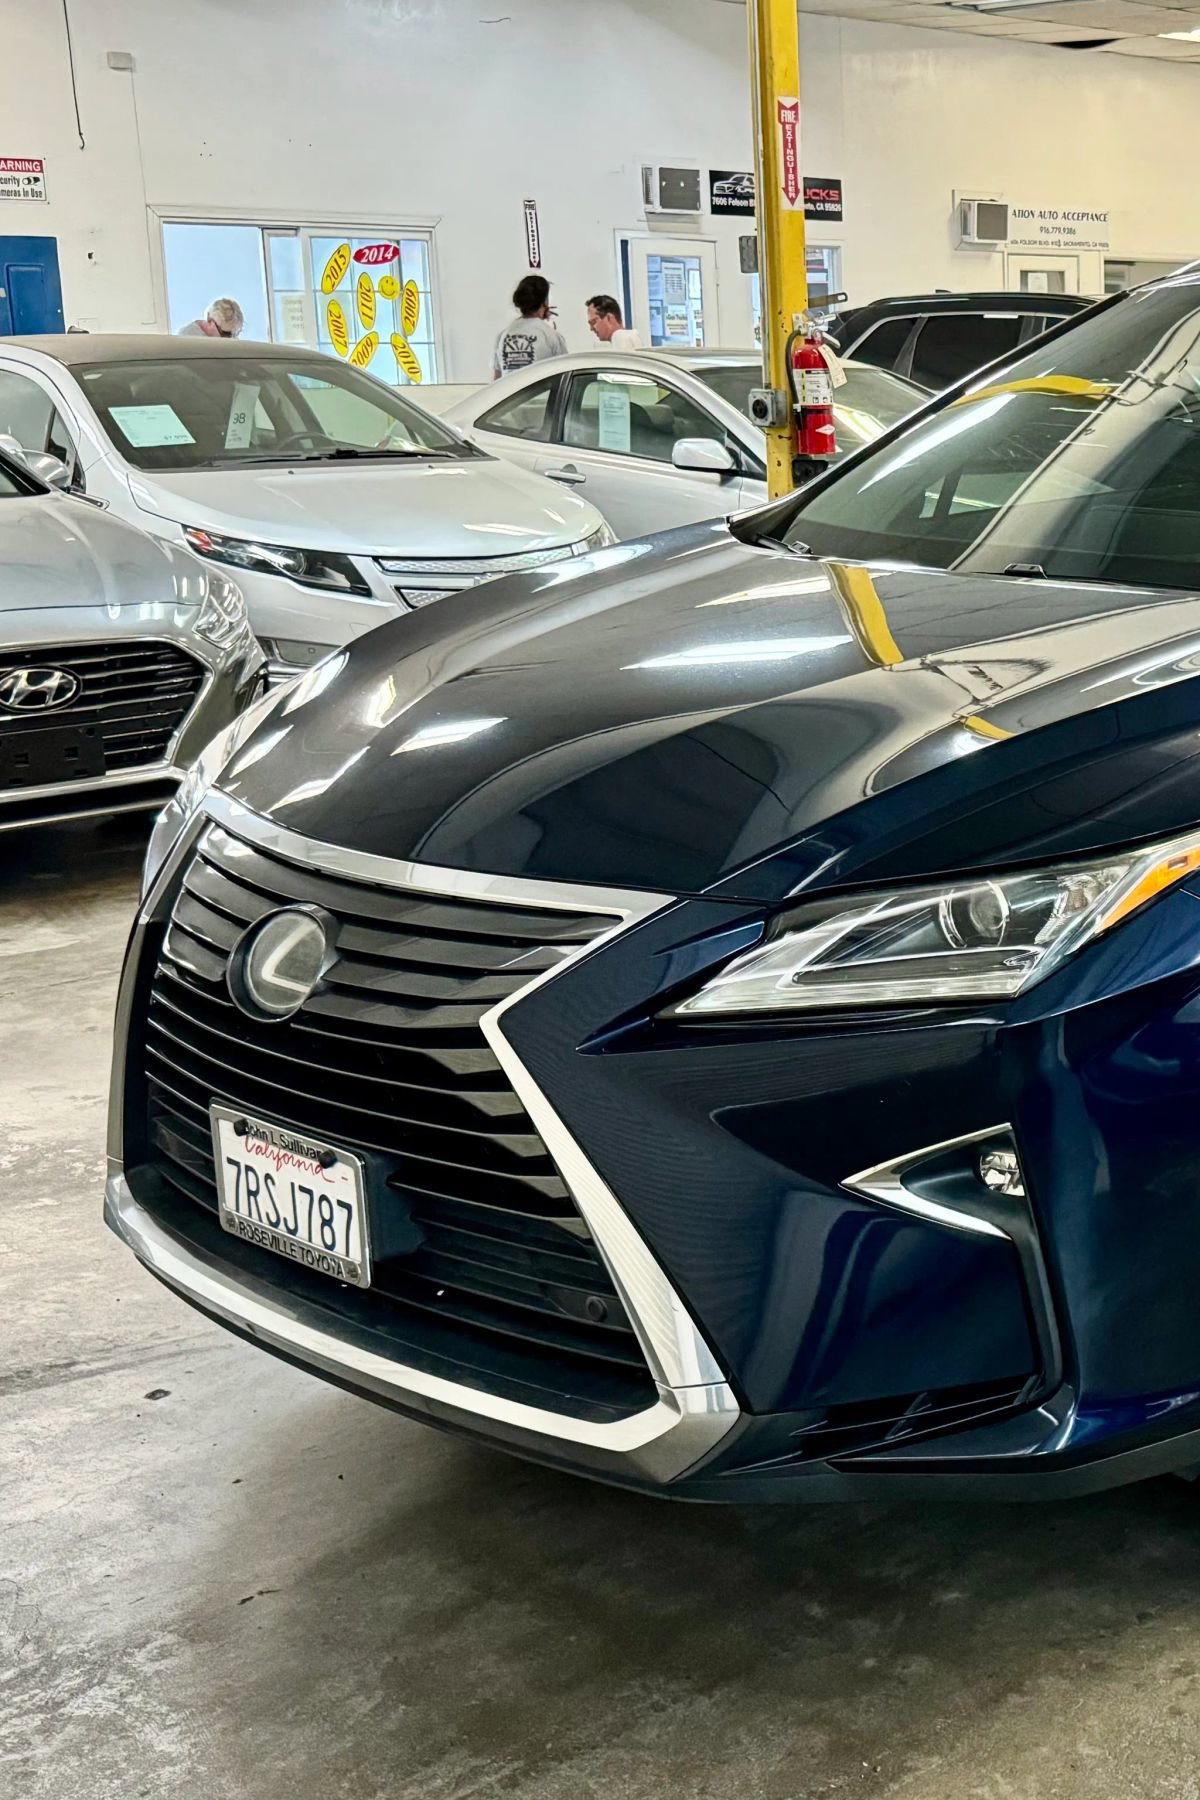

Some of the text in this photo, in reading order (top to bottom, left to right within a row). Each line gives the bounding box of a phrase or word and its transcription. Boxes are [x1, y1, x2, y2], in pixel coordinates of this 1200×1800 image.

[781, 109, 796, 123] FIRE
[0, 160, 41, 172] ARNING
[785, 124, 796, 199] EXTINGUISHER
[0, 175, 20, 188] curity
[0, 189, 21, 198] meras
[803, 188, 840, 201] UCKS
[728, 197, 749, 207] Folsom
[1011, 209, 1109, 222] ATION AUTO ACCEPTANCE
[361, 246, 394, 263] 2014
[325, 248, 348, 290] 2015
[359, 281, 374, 321] 2011
[403, 287, 418, 329] 2009
[328, 309, 348, 350] 2007
[393, 343, 421, 375] 2010
[246, 1122, 269, 1142] ohn
[270, 1130, 278, 1146] L
[244, 1131, 336, 1184] California
[226, 1156, 353, 1259] 7RSJ787
[238, 1221, 347, 1279] ROSEVILLE TOYOTA
